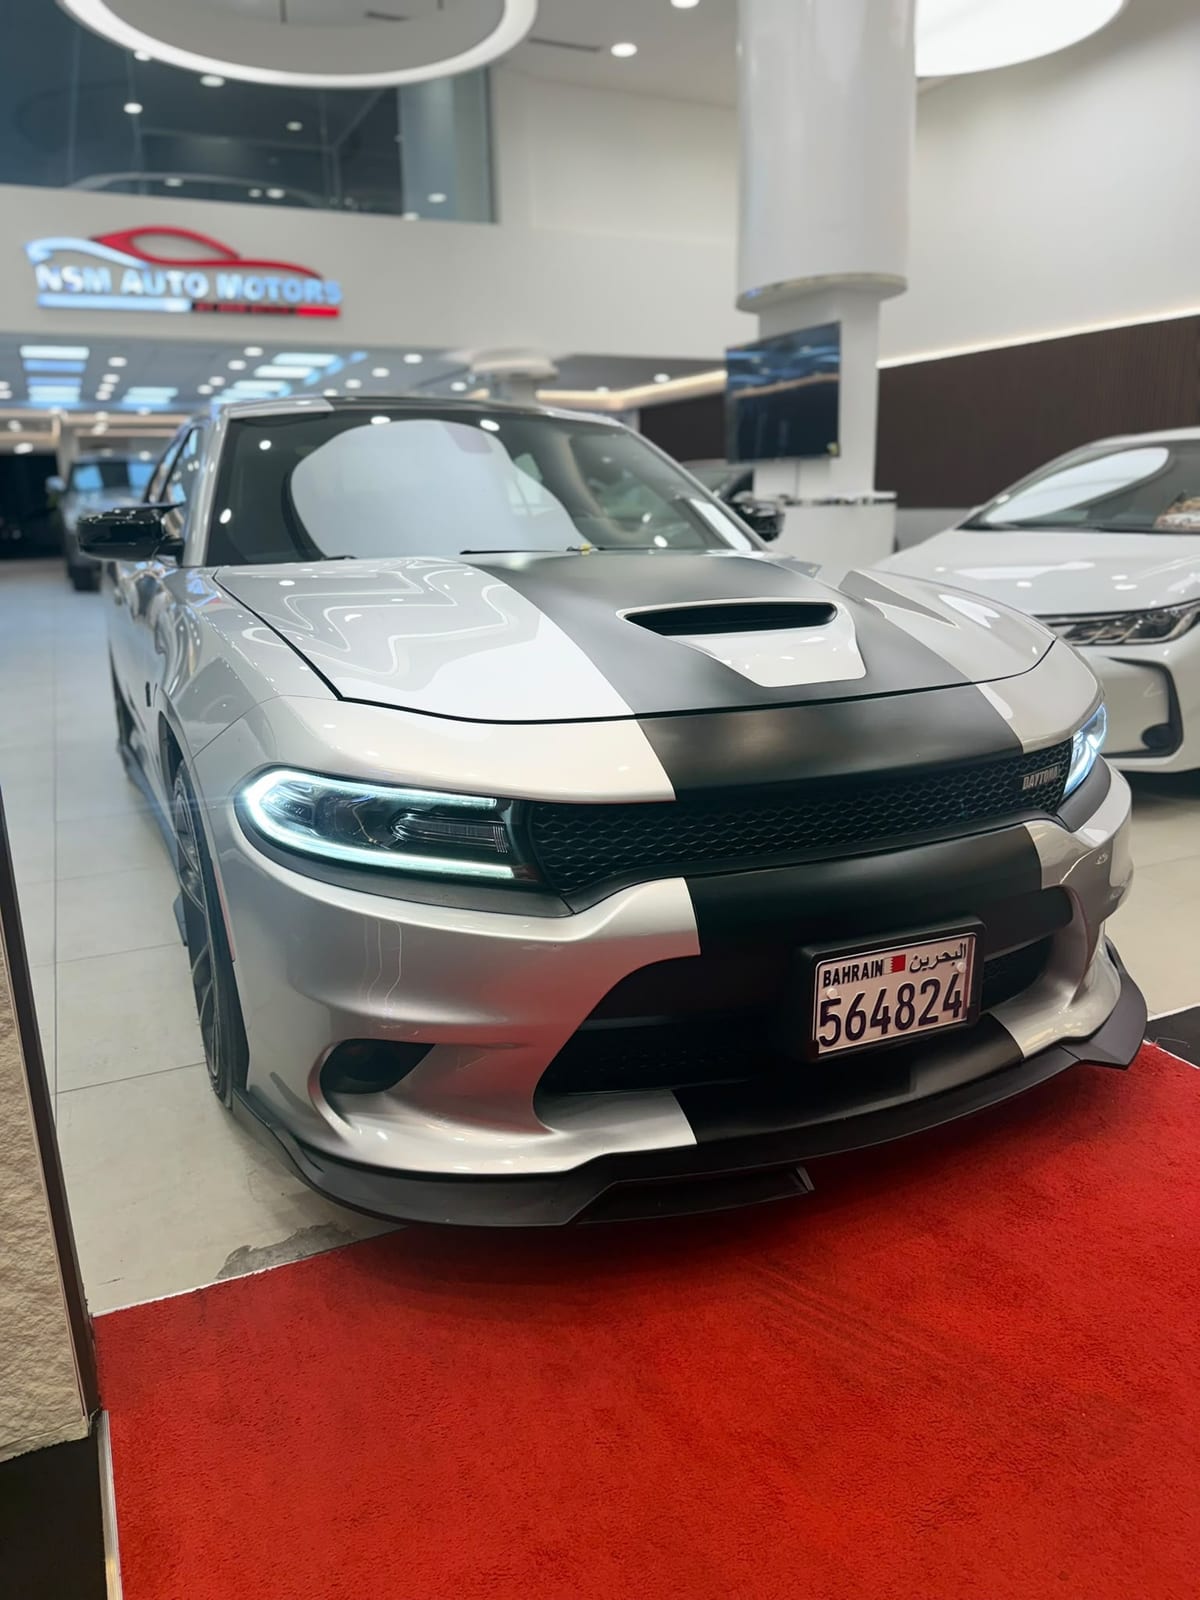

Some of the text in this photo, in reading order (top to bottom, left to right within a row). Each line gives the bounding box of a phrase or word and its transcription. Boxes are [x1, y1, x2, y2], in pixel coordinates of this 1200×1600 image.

[36, 264, 343, 304] NSM AUTO MOTORS
[823, 959, 884, 988] BAHRAIN
[909, 942, 967, 973] البحرين
[819, 973, 962, 1047] 564824
